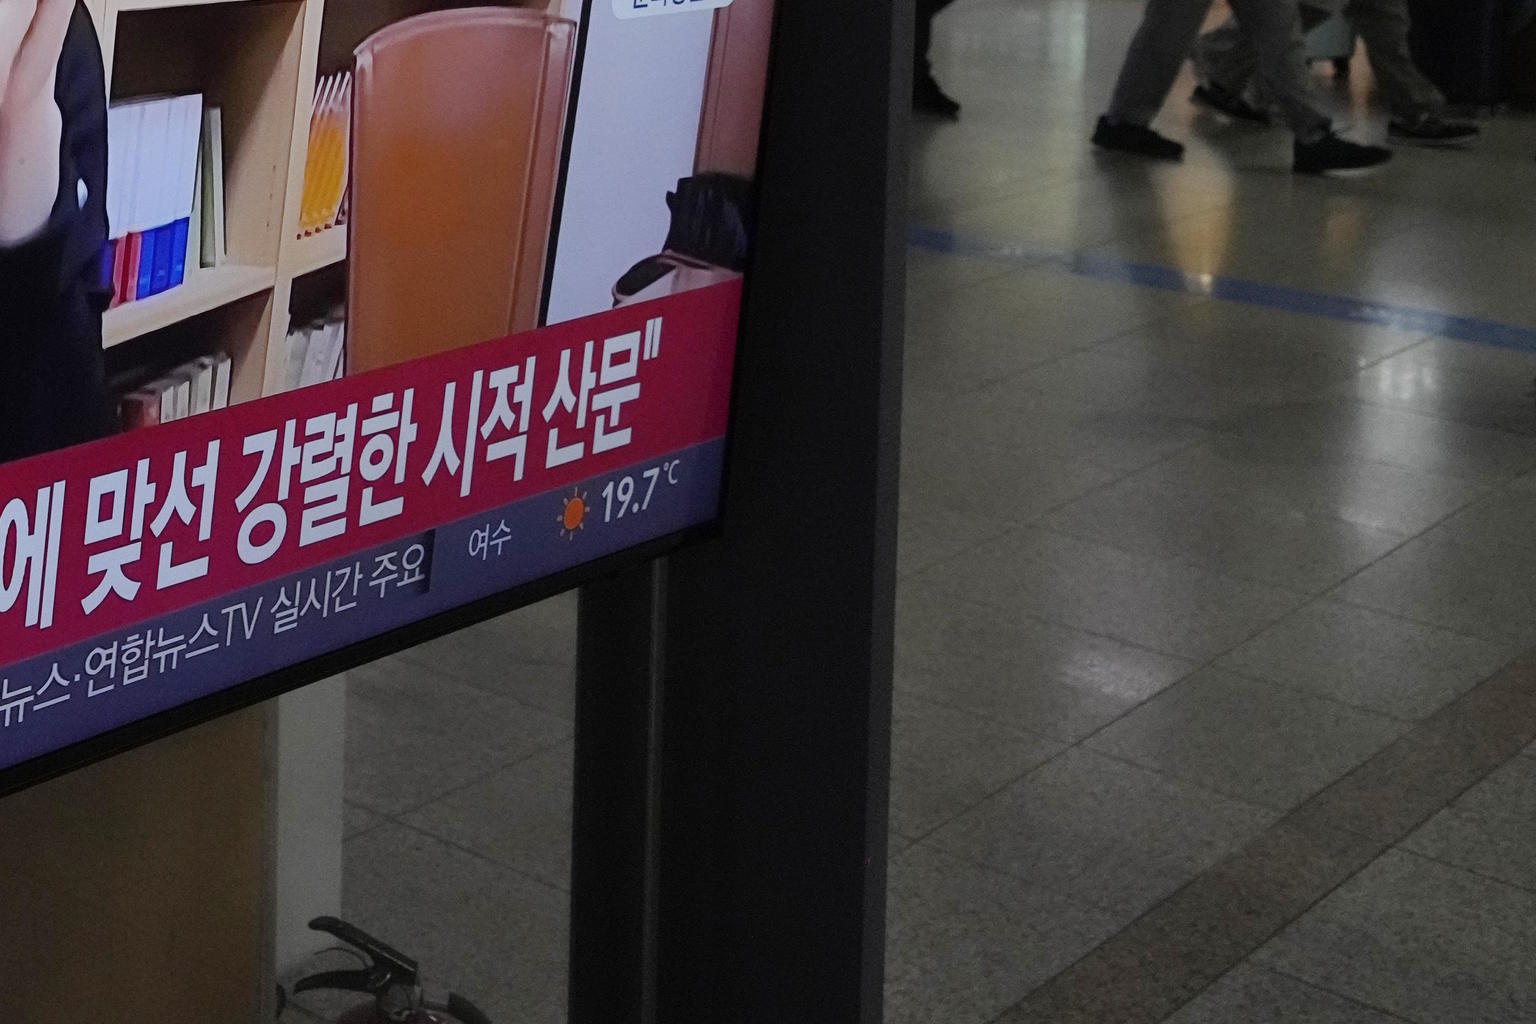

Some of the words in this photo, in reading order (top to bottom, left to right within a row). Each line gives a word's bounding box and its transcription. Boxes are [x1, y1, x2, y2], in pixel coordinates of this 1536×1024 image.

[80, 439, 215, 613] 맞선
[233, 385, 418, 566] 강렬한
[423, 342, 535, 499] 시적
[540, 317, 664, 470] 산문"
[468, 520, 511, 560] 여수
[270, 562, 362, 635] 실시간
[369, 543, 425, 599] 주요
